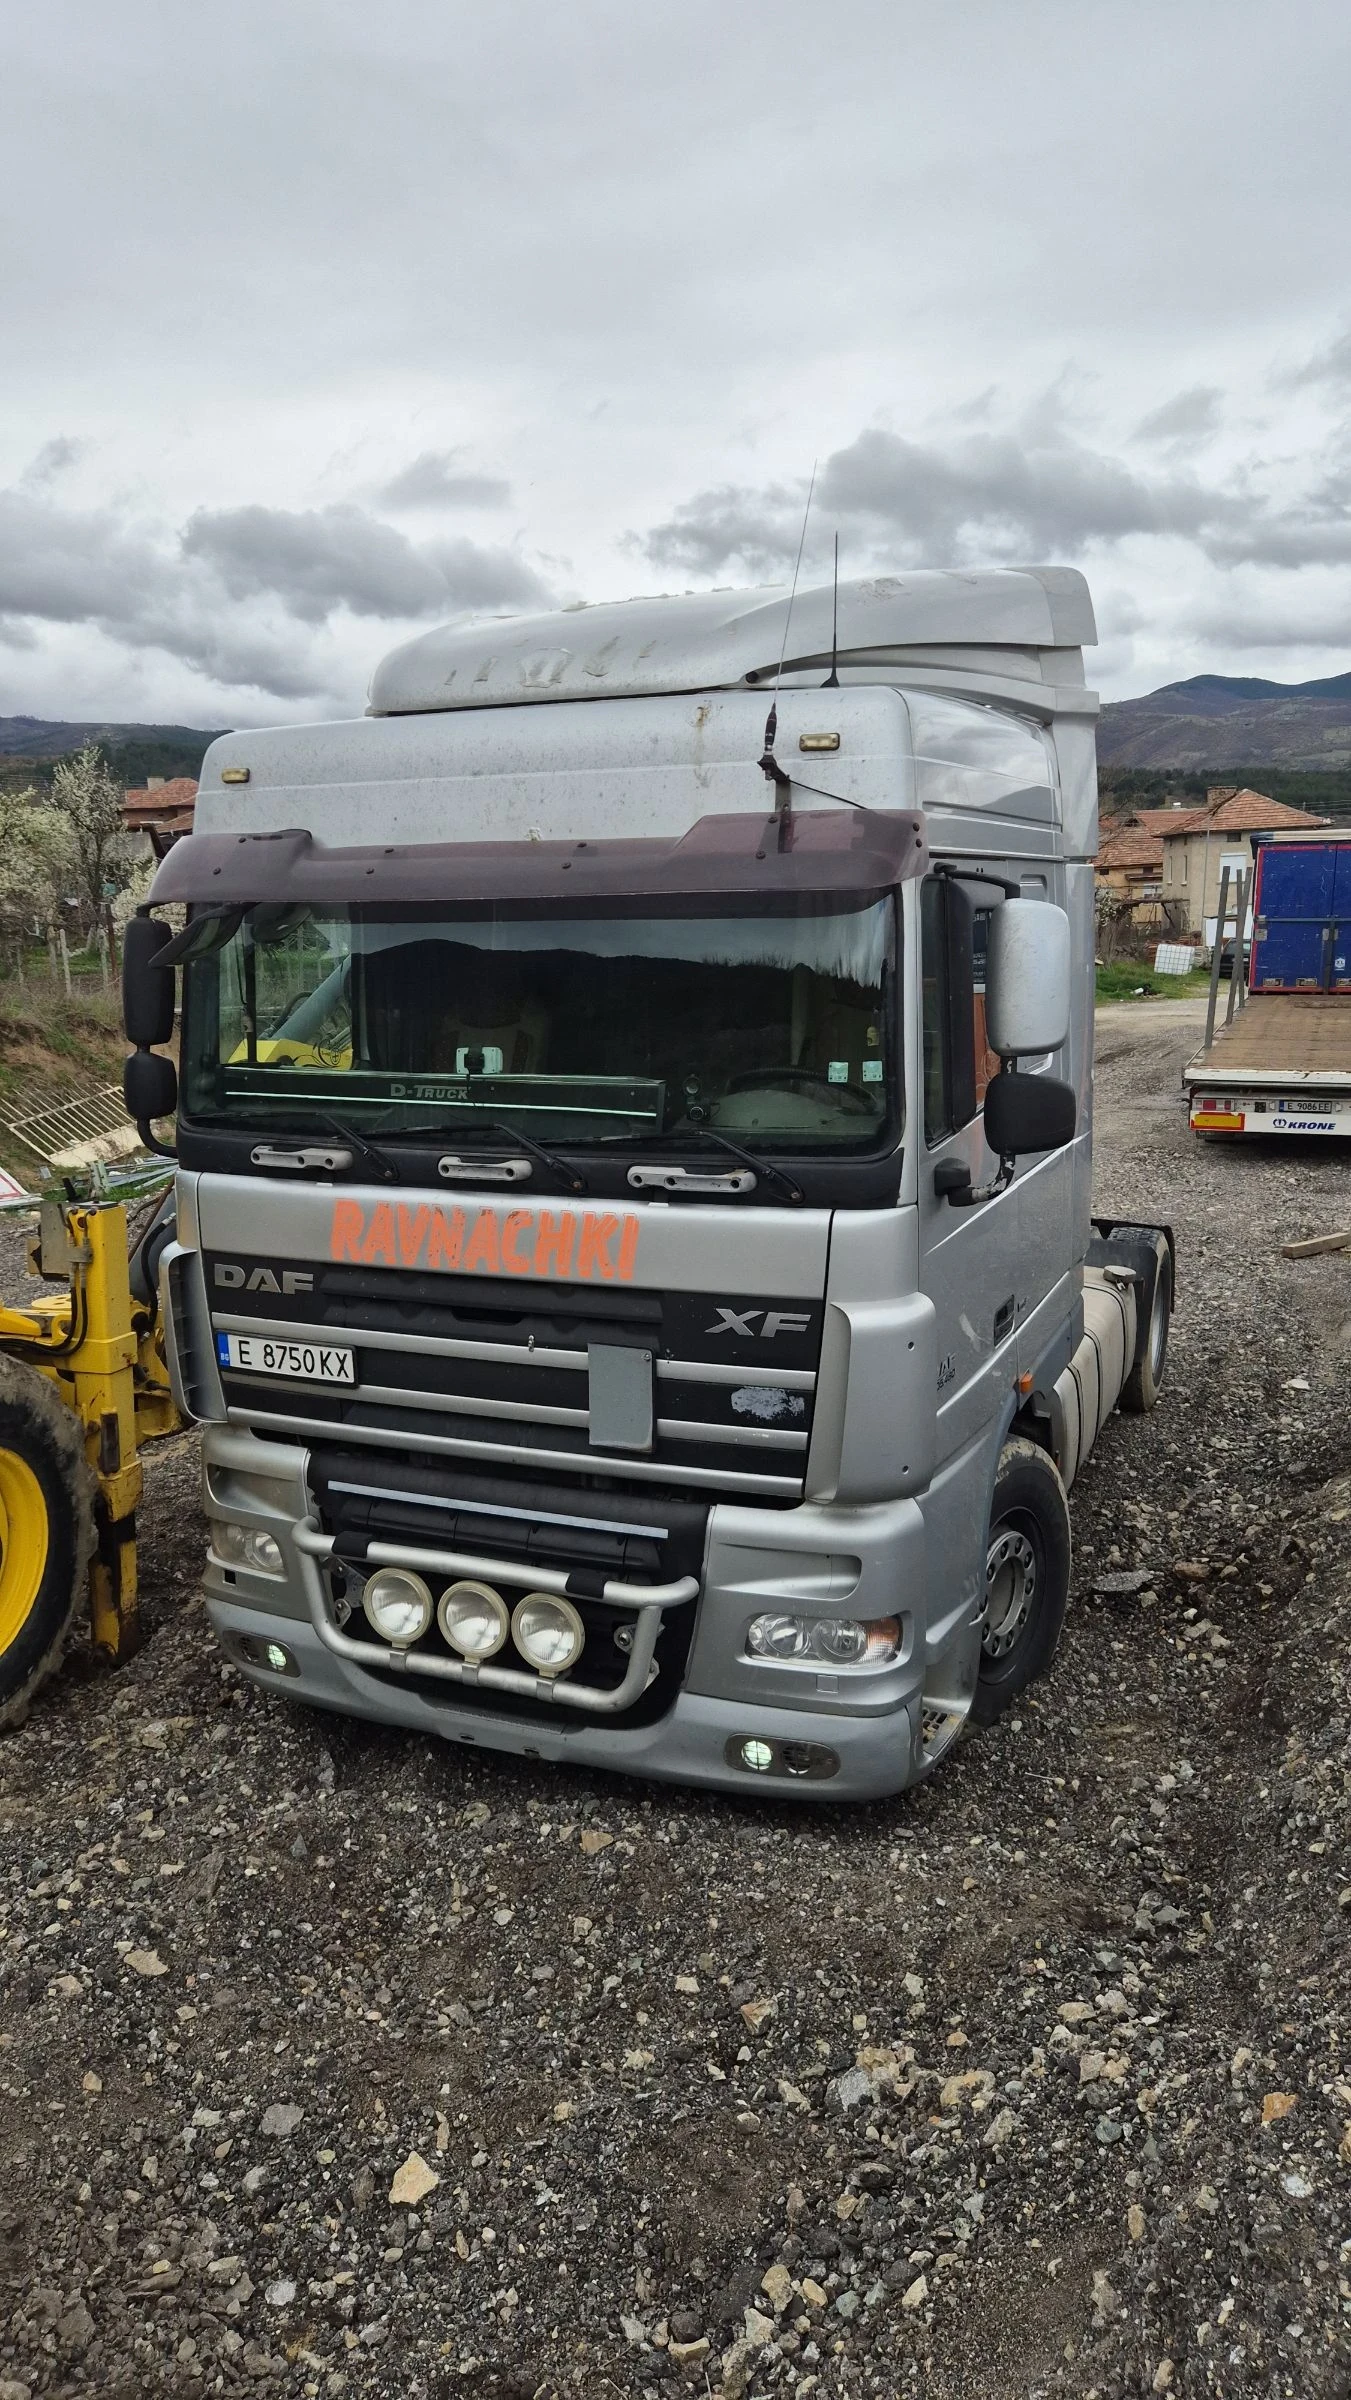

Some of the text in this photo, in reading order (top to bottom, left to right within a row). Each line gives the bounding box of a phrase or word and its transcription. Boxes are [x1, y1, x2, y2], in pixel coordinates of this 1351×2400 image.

[390, 1083, 471, 1099] D-TRUCK
[1288, 1122, 1336, 1130] KRONE
[330, 1198, 639, 1281] RAVNACHKI
[214, 1263, 313, 1295] DAF
[704, 1308, 811, 1337] XF
[238, 1339, 252, 1365] E
